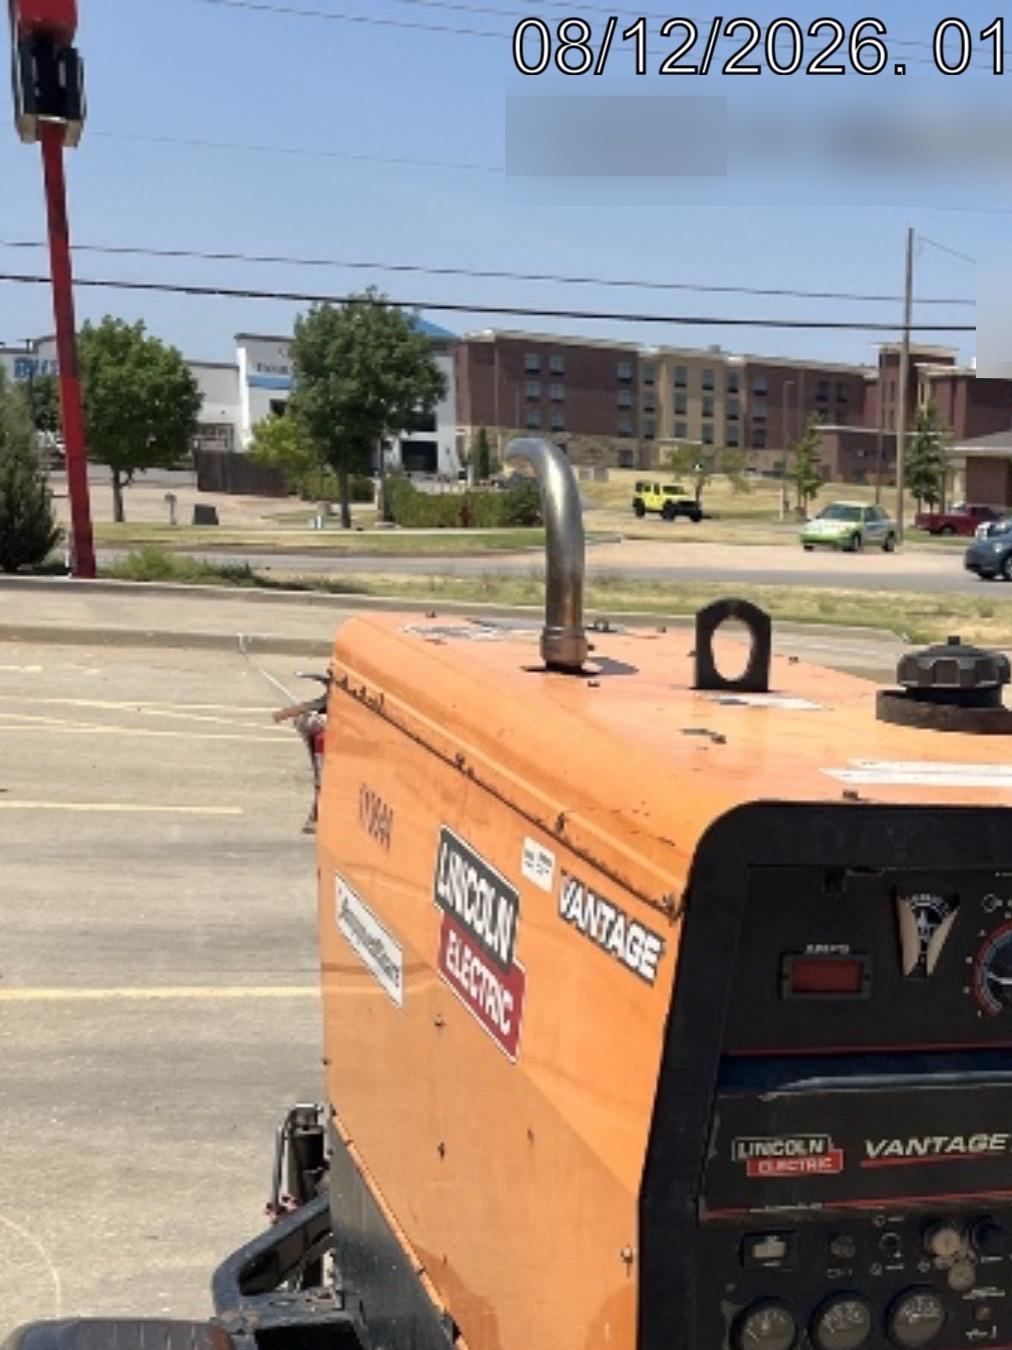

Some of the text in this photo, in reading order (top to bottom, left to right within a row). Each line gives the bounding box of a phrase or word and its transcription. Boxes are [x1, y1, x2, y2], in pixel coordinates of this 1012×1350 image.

[437, 842, 514, 963] LINCOLN
[559, 877, 661, 981] VANTAGE
[445, 930, 513, 1036] ELECTRIC
[737, 1138, 824, 1158] LINCOLN
[758, 1156, 832, 1174] ELECTRIC
[864, 1133, 1012, 1159] VANTAGE
